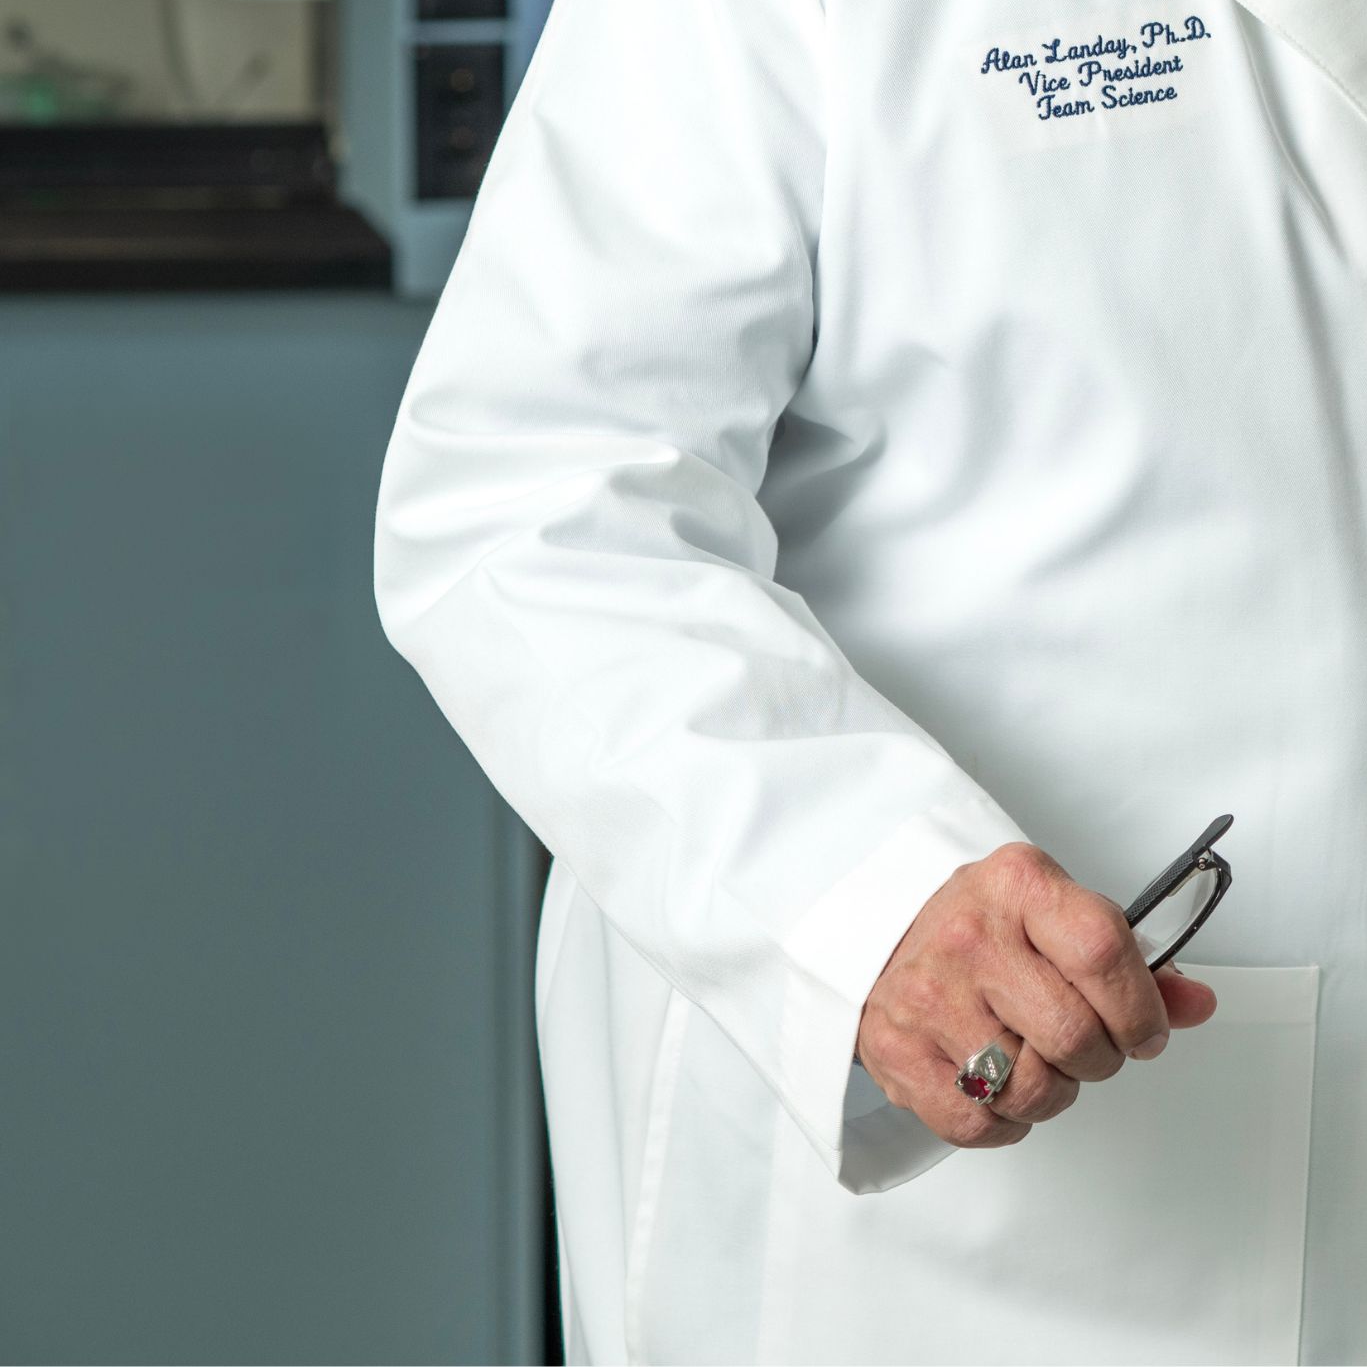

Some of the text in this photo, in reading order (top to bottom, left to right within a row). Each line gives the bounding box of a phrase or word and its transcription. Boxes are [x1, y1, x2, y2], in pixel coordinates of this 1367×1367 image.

[981, 16, 1211, 74] Alan Landay, Ph.D.
[1018, 55, 1184, 96] Vice President
[1036, 85, 1178, 120] Team Science
